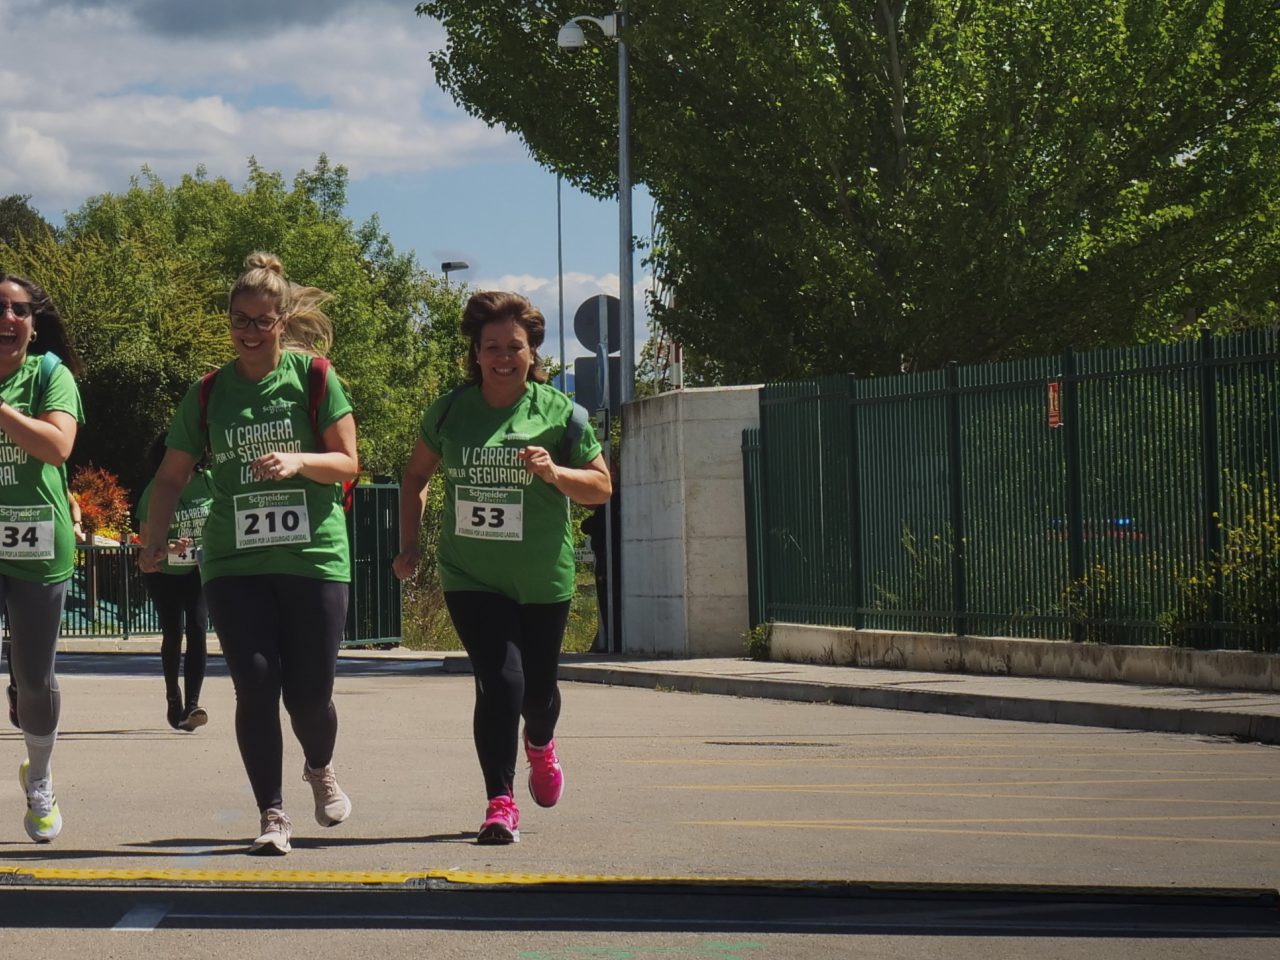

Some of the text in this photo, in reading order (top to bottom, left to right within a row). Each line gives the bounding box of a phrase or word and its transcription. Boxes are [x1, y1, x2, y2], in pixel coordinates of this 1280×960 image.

[225, 418, 293, 448] V CARRERA
[462, 446, 469, 465] V
[249, 493, 289, 505] Schneider
[469, 489, 508, 500] Schneider
[0, 508, 40, 519] Schneider
[244, 510, 300, 536] 210
[471, 506, 505, 529] 53
[2, 526, 39, 548] 34
[178, 548, 196, 560] 41
